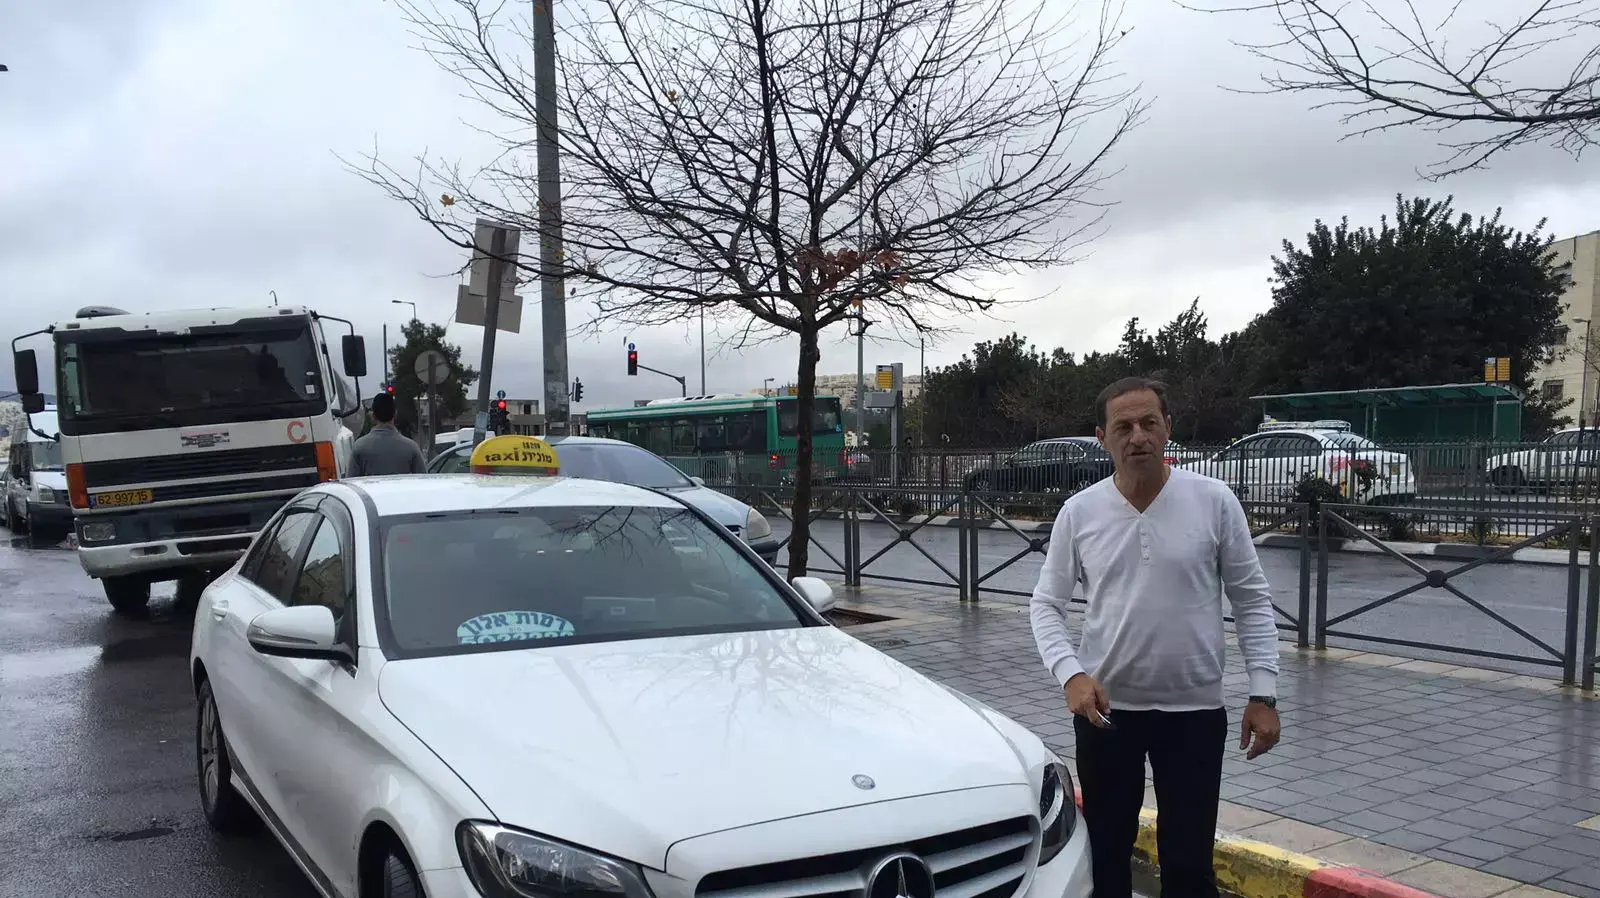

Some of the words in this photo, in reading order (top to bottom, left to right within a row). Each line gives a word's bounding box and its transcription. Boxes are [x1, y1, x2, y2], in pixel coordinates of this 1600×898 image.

[287, 421, 307, 443] C
[485, 448, 519, 462] taxi
[522, 451, 552, 463] מונית
[462, 615, 508, 635] אלון
[515, 612, 566, 631] רמות
